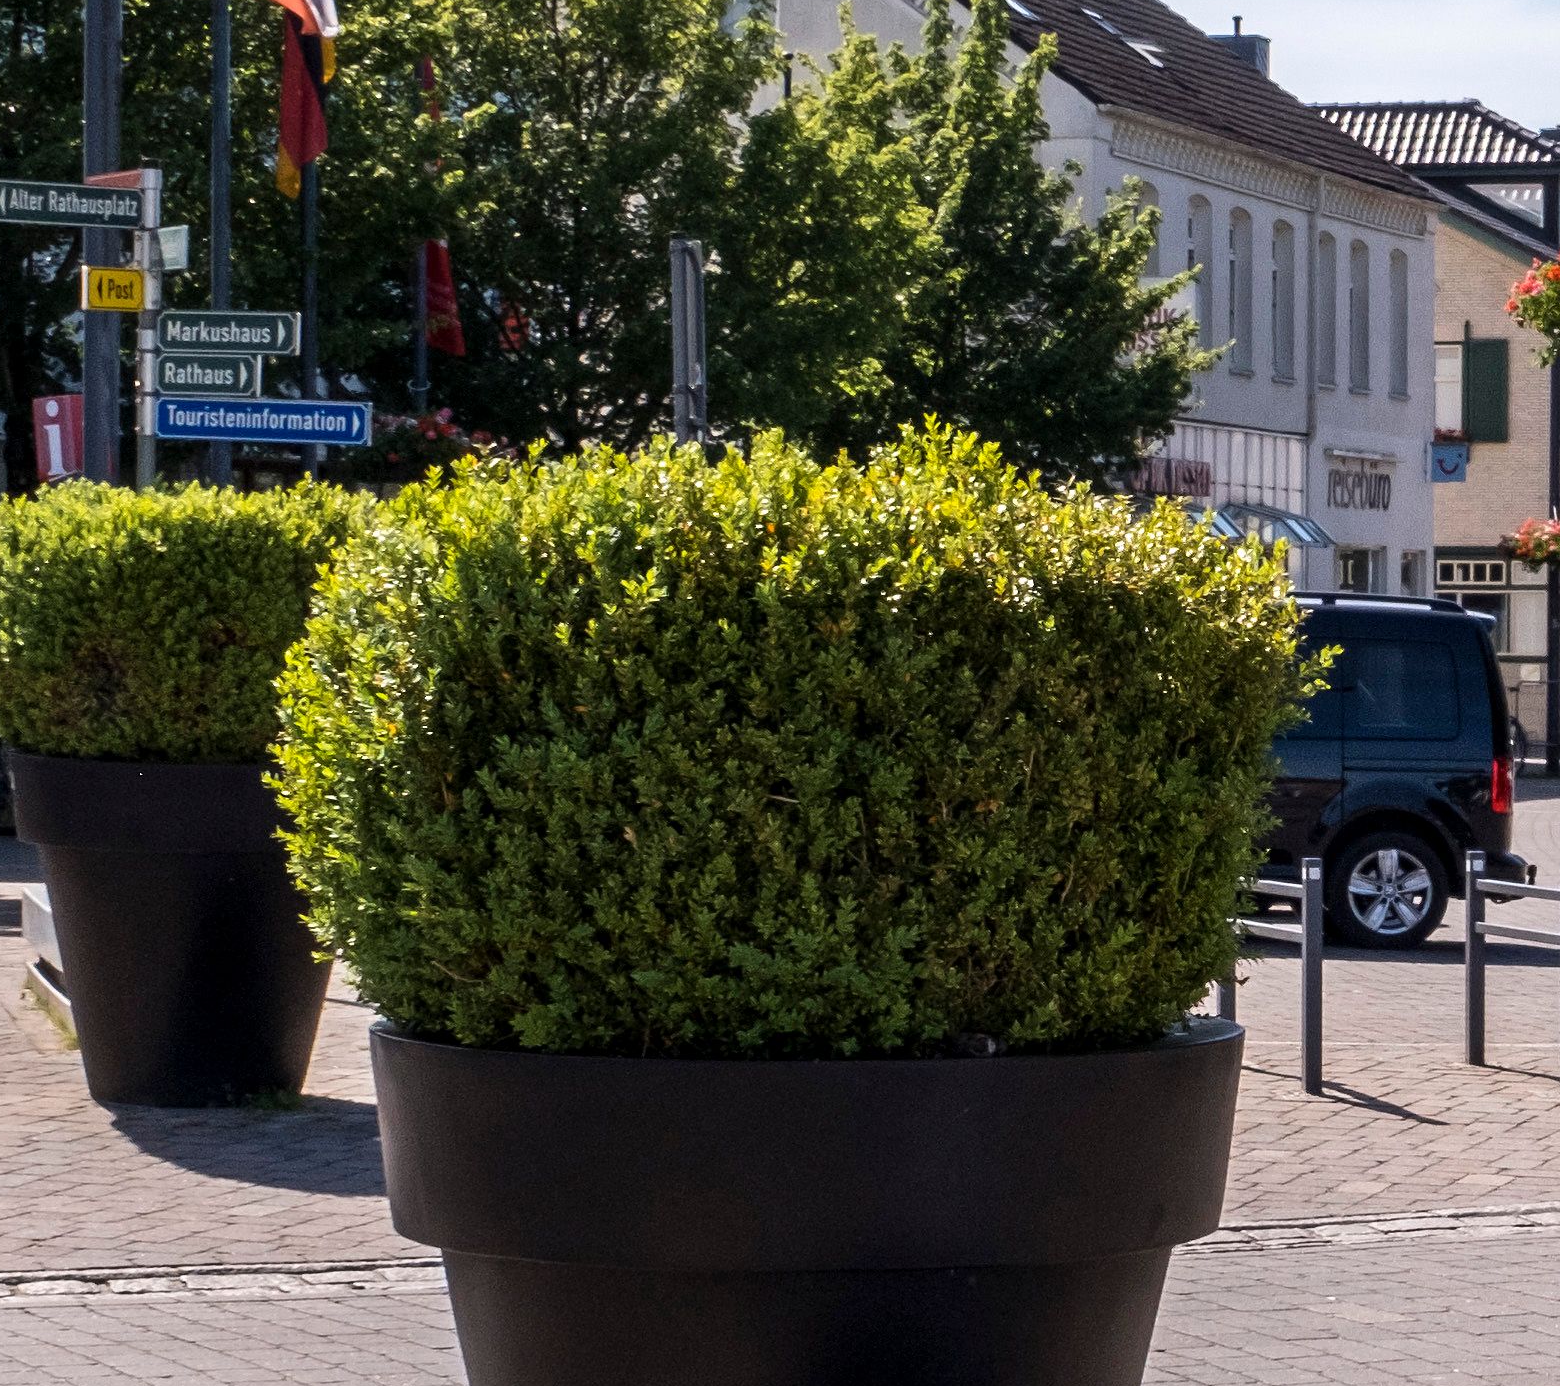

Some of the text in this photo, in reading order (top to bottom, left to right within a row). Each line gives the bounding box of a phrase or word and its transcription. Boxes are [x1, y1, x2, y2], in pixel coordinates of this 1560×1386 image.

[10, 188, 138, 221] Alter Rathausplatz
[107, 278, 134, 301] Post
[167, 320, 271, 344] Markushaus
[164, 362, 234, 385] Rathaus
[166, 404, 347, 433] Touristeninformation
